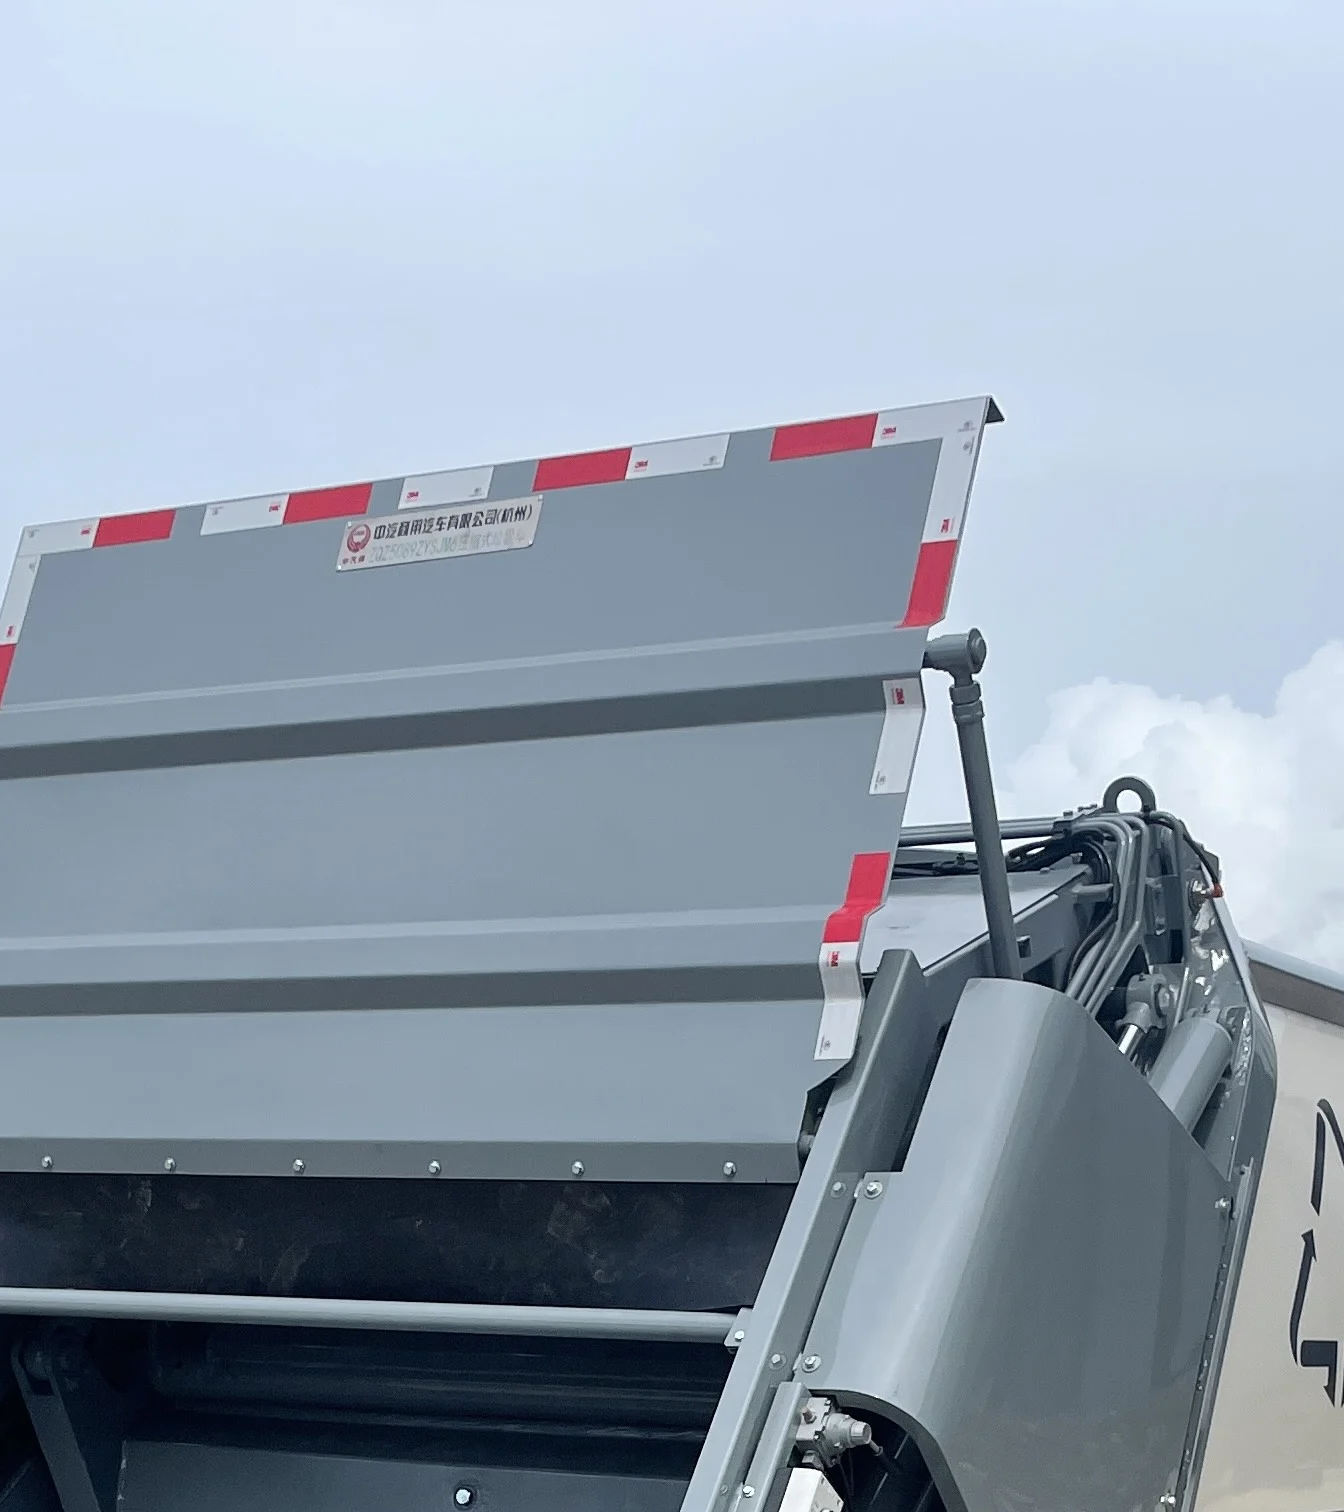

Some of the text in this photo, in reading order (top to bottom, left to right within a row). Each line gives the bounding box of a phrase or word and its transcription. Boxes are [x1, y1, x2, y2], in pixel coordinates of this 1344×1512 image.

[373, 503, 533, 540] 中汽商用汽车有限公司(杭州)
